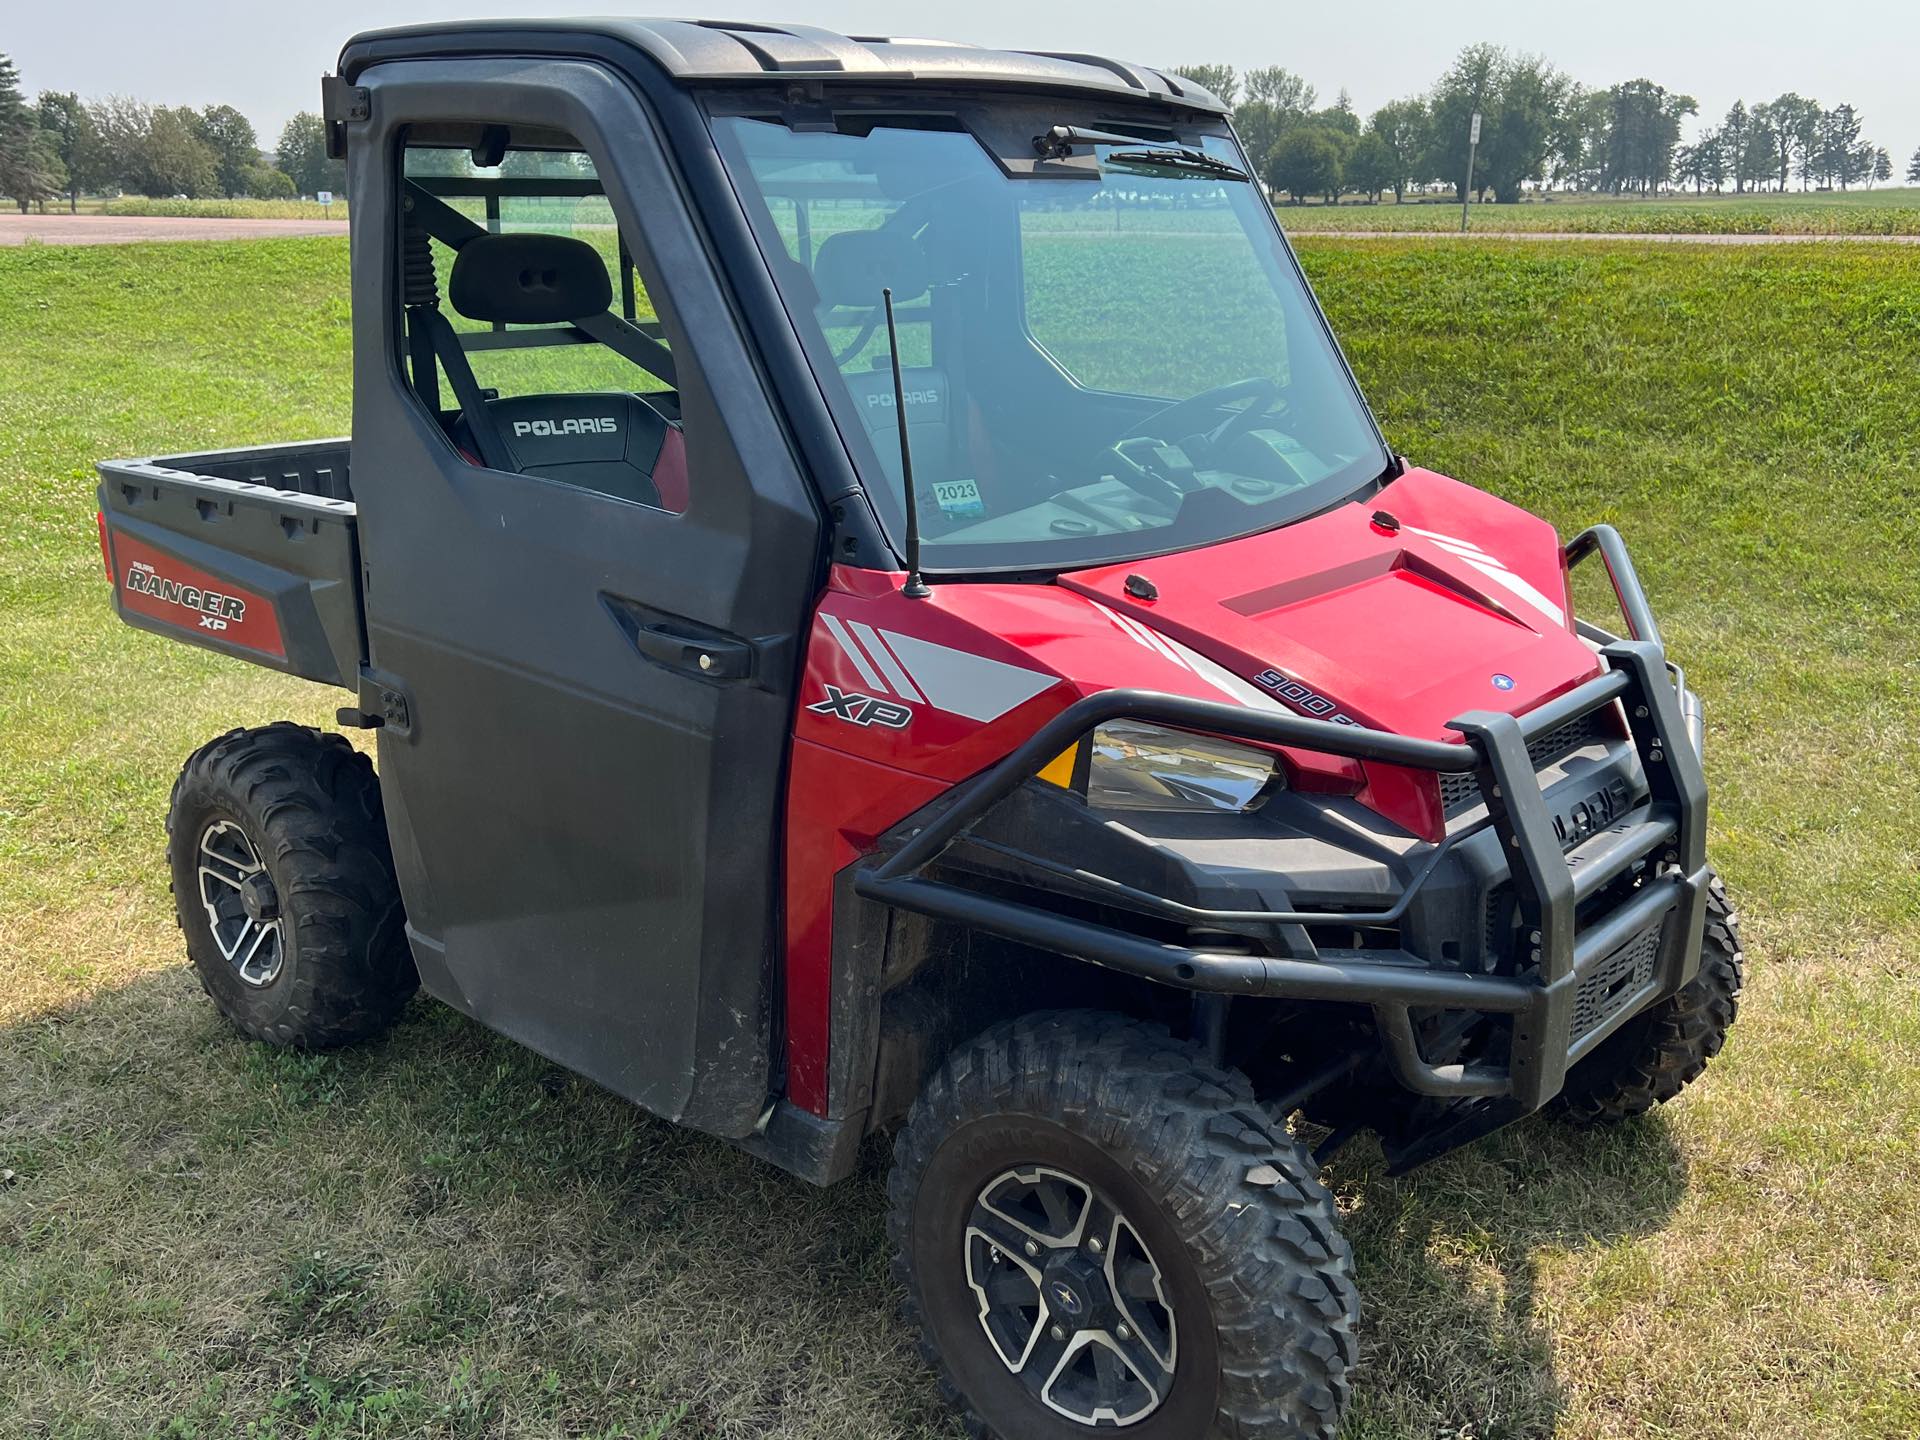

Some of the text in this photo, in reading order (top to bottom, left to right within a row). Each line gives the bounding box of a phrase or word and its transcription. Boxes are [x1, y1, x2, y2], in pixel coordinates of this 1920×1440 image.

[513, 418, 617, 437] POLARIS
[938, 484, 976, 500] 2023
[126, 568, 245, 622] RANGER
[199, 615, 227, 630] XP
[805, 684, 912, 728] XP
[1254, 669, 1336, 715] 900
